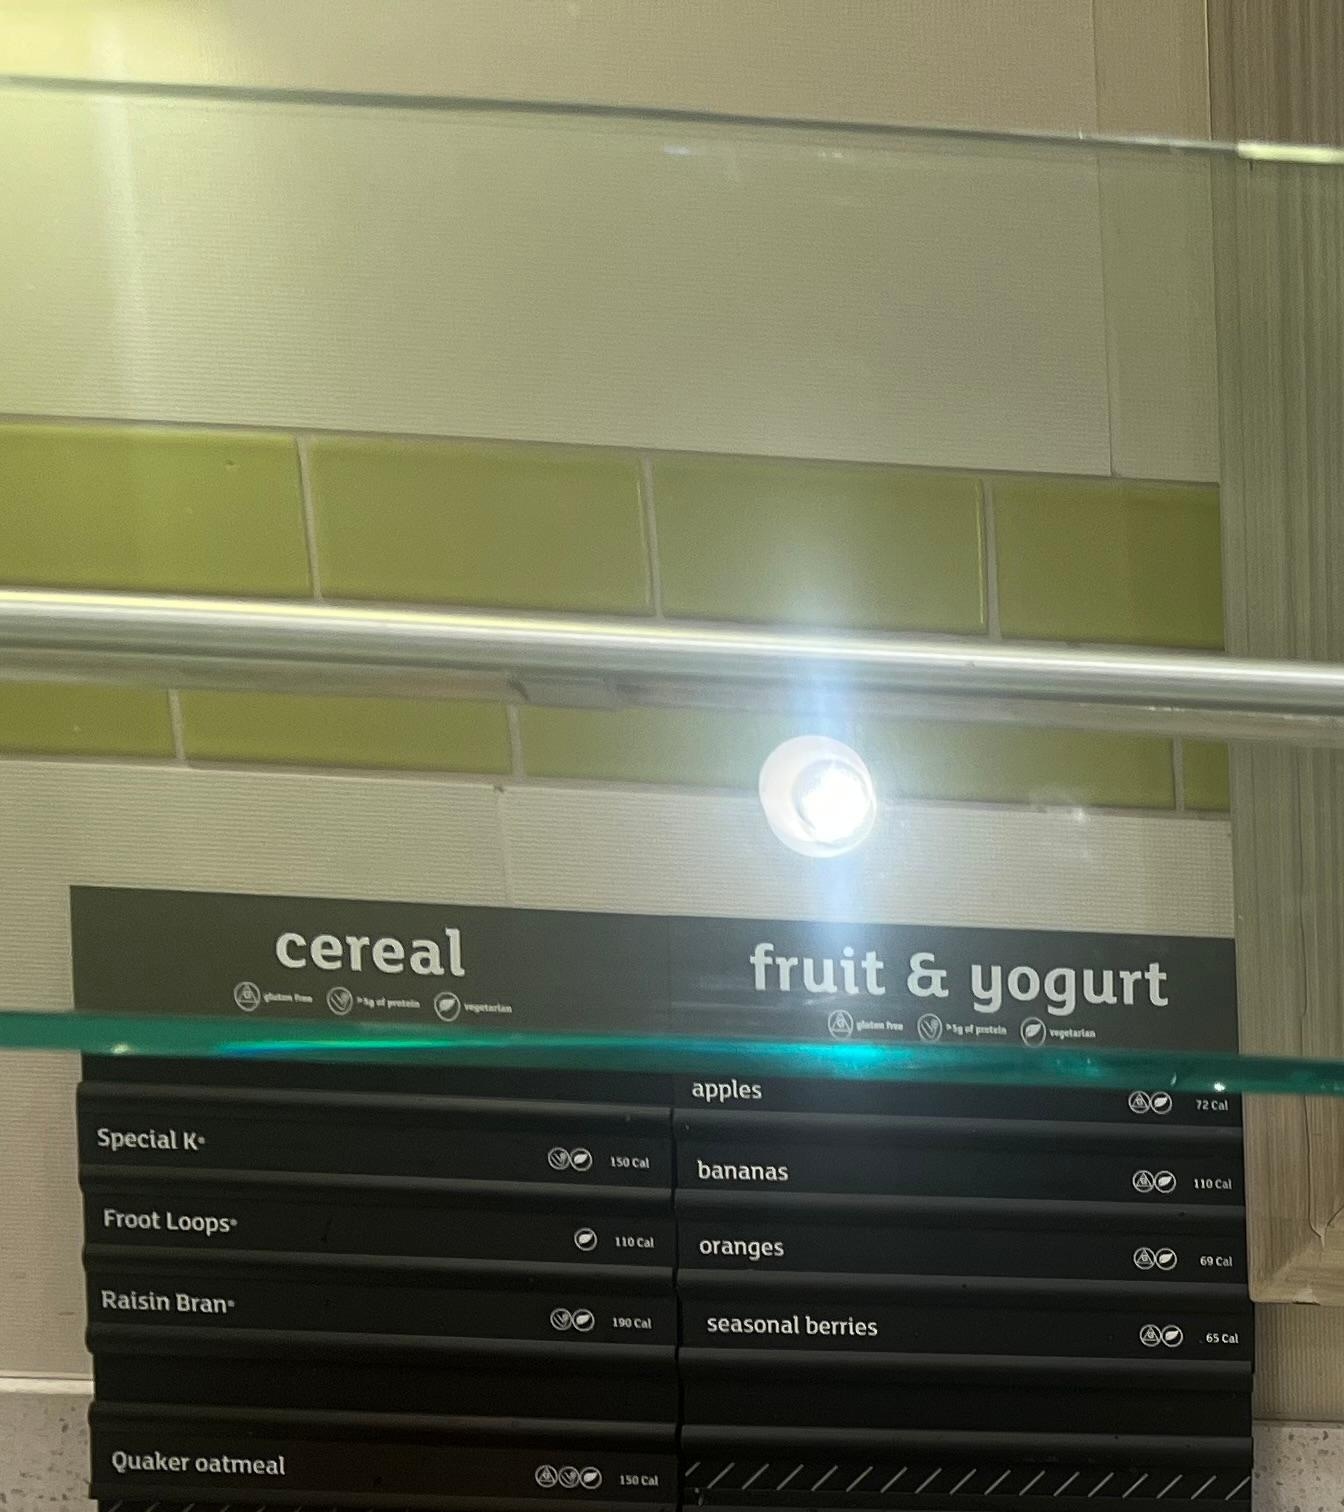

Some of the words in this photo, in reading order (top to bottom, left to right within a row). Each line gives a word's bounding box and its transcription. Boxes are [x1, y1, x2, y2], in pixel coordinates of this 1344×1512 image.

[275, 927, 466, 977] cereal
[750, 942, 887, 997] fruit
[907, 952, 949, 998] &
[971, 962, 1169, 1017] yogurt
[463, 1003, 513, 1013] vegetarian
[1049, 1028, 1096, 1040] vegetarian
[692, 1078, 762, 1103] apples
[1196, 1099, 1209, 1110] 72
[1210, 1099, 1229, 1111] Cal
[97, 1127, 178, 1152] Special
[610, 1156, 630, 1168] 150
[631, 1157, 650, 1169] Cal
[697, 1159, 789, 1181] bananas
[1194, 1178, 1213, 1189] 110
[1214, 1178, 1232, 1190] Cal
[103, 1209, 161, 1230] Froot
[615, 1236, 635, 1248] 110
[636, 1237, 655, 1248] Cal
[699, 1240, 785, 1261] oranges
[1200, 1255, 1214, 1266] 69
[1215, 1256, 1233, 1267] Cal
[101, 1290, 170, 1311] Raisin
[612, 1317, 632, 1328] 190
[633, 1317, 652, 1329] Cal
[707, 1315, 800, 1335] seasonal
[805, 1315, 878, 1336] berries
[1205, 1333, 1220, 1343] 65
[1221, 1332, 1239, 1344] Cal
[111, 1450, 190, 1473] Quaker
[195, 1455, 286, 1476] oatmeal
[620, 1474, 640, 1486] 150
[640, 1475, 659, 1486] Cal
